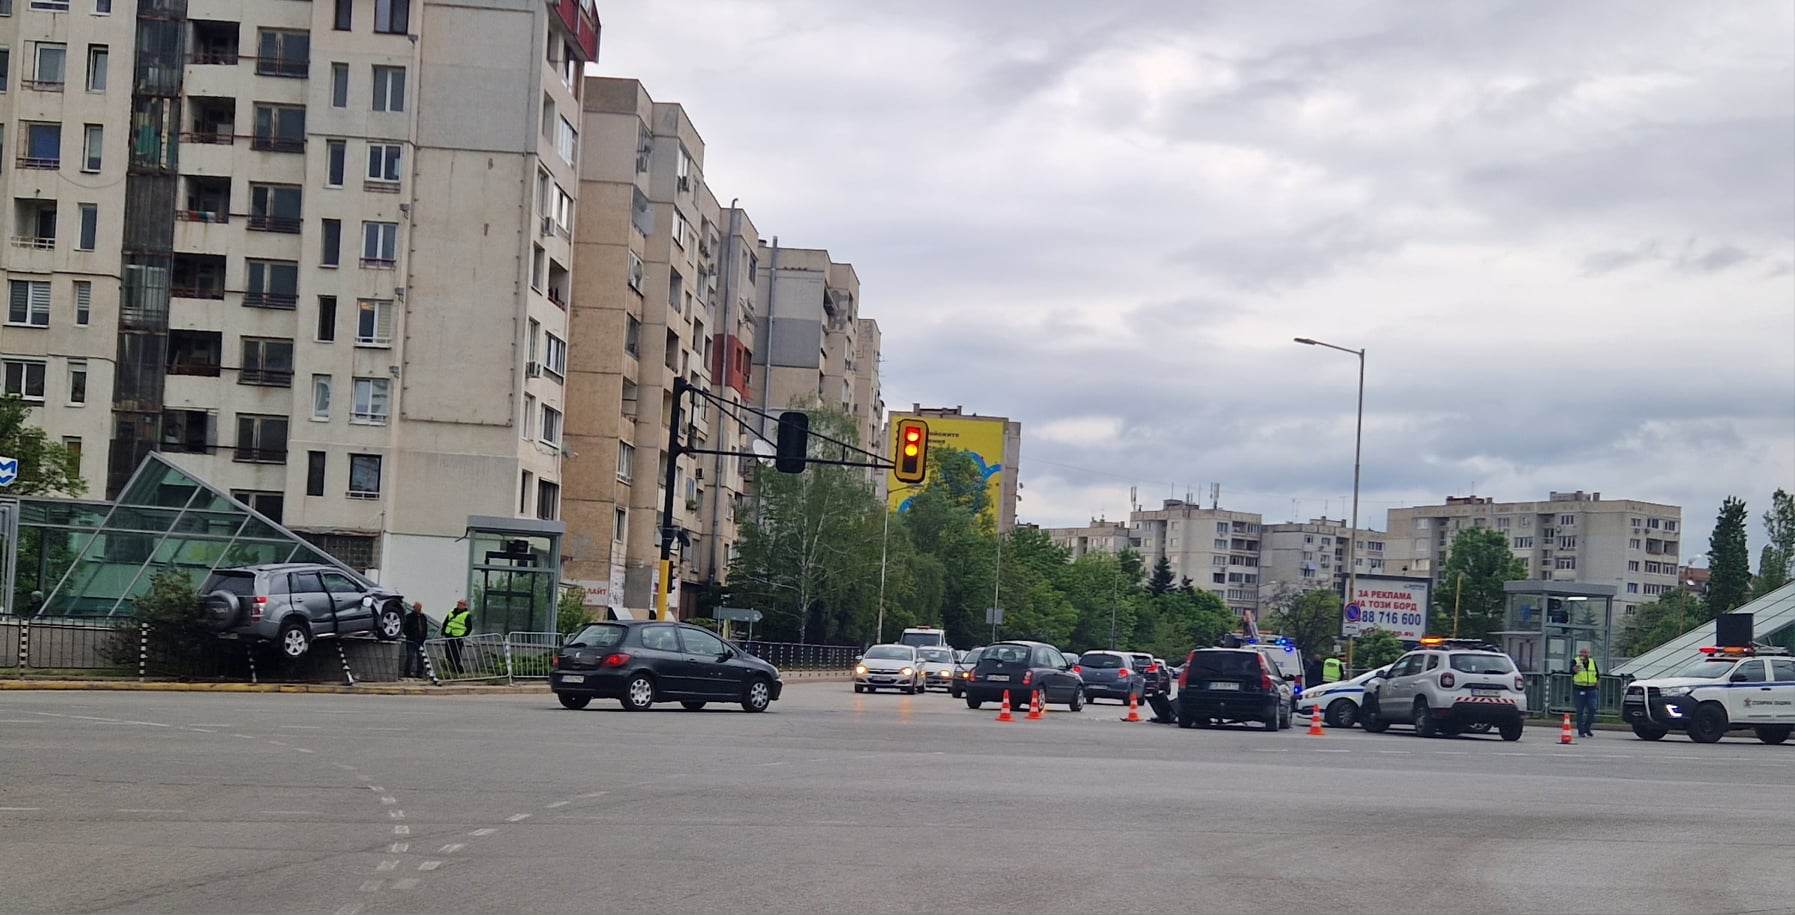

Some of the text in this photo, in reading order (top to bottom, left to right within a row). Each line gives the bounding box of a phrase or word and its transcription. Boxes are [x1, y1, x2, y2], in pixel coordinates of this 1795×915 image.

[1359, 590, 1412, 600] ЗА РЕКЛАМА
[1369, 600, 1391, 609] ТОЗИ
[1393, 602, 1417, 611] БОРД
[1379, 611, 1398, 624] 716
[1401, 613, 1422, 626] 600
